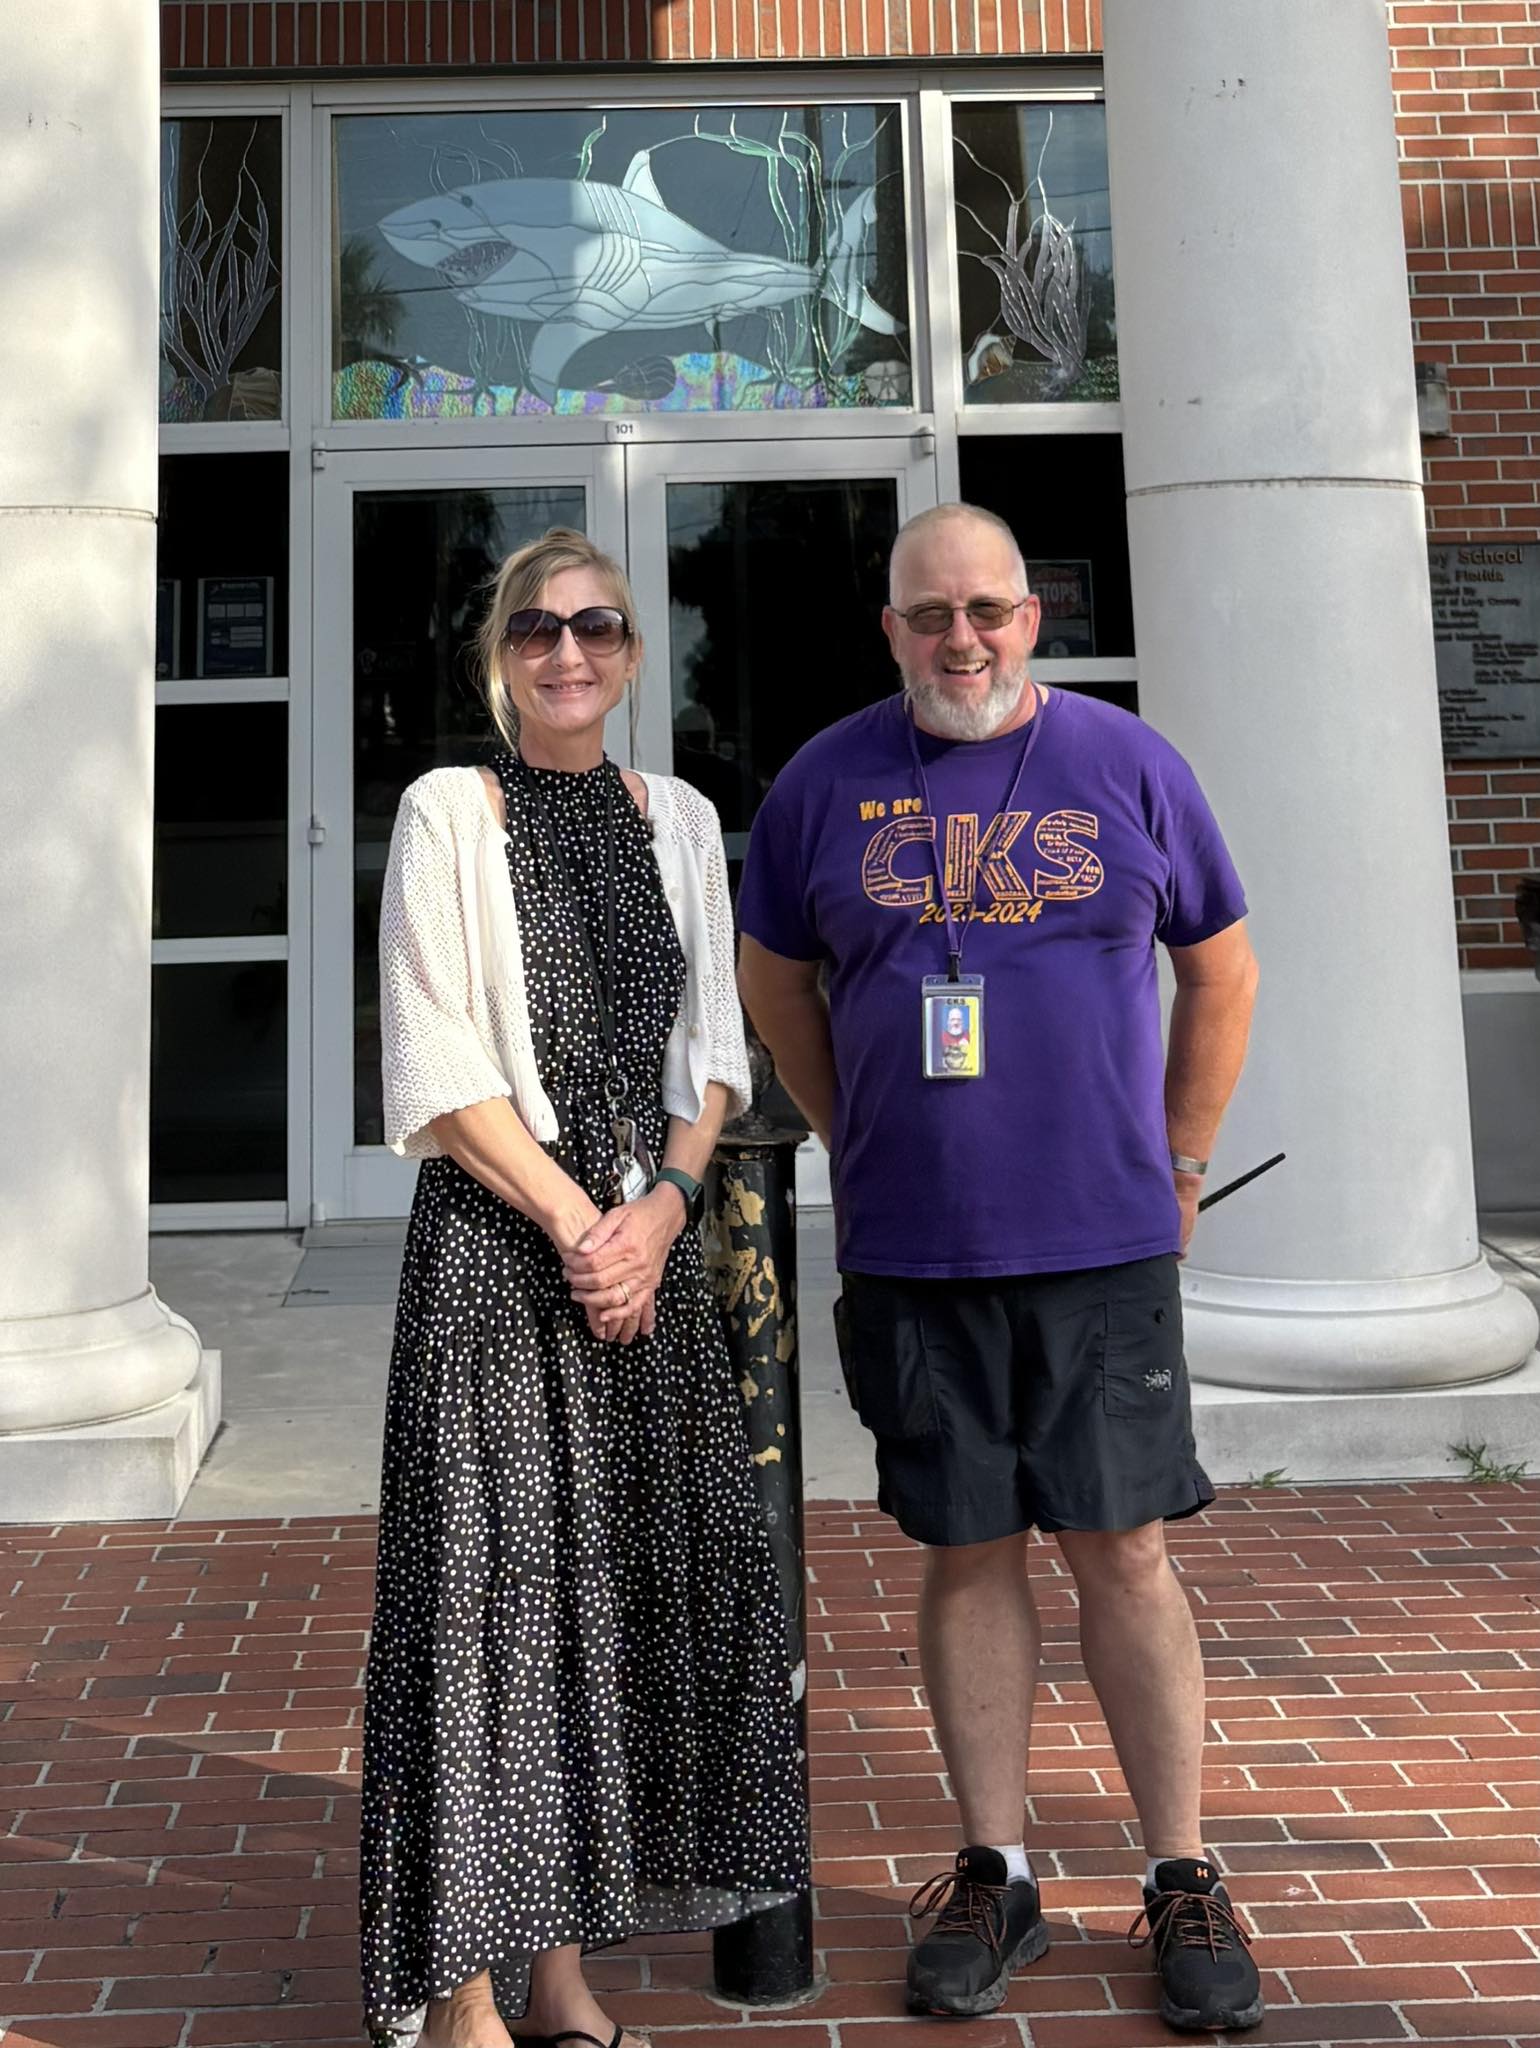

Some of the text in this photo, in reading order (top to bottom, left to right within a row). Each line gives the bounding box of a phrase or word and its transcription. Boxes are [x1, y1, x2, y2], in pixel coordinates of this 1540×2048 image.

[616, 424, 633, 434] 101
[1459, 546, 1523, 564] School
[1456, 568, 1505, 582] Florida
[859, 798, 922, 821] We are
[862, 810, 1105, 906] CKS
